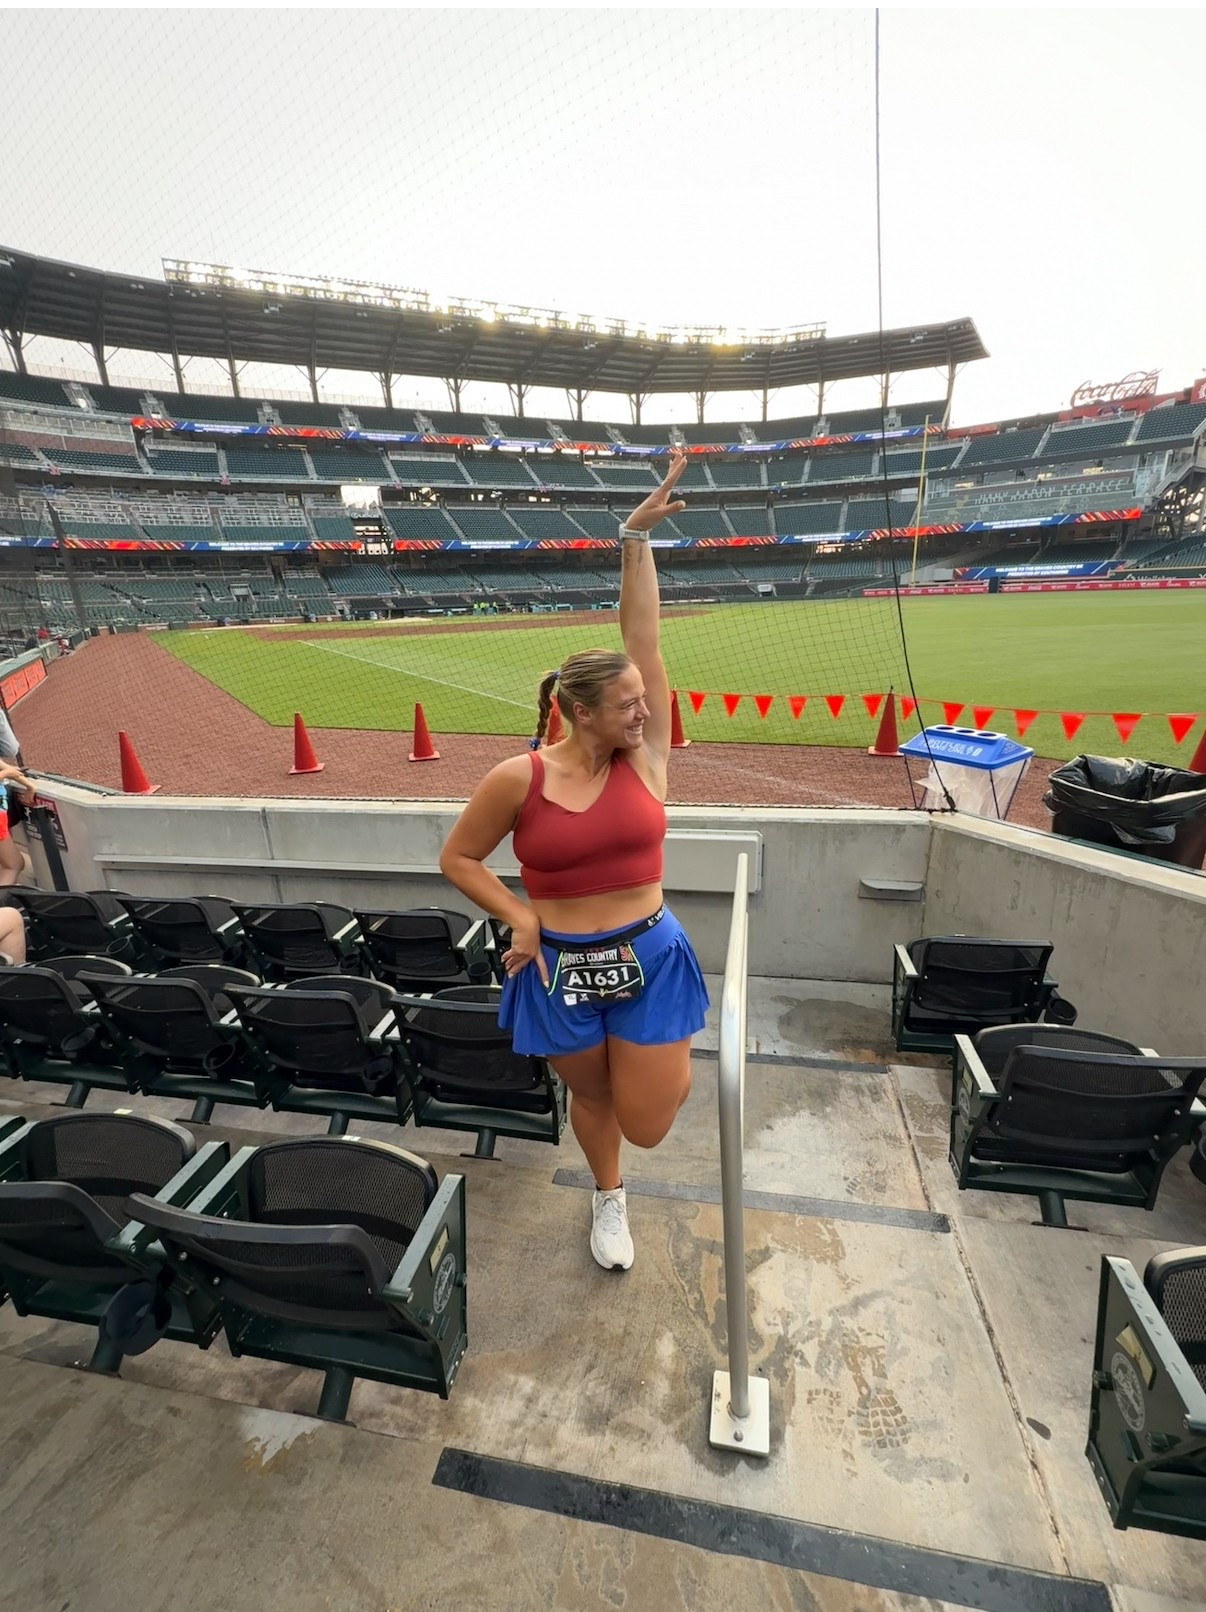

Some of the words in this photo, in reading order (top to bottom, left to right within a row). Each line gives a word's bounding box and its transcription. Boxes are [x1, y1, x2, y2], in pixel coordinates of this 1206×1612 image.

[975, 491, 1009, 505] HANK
[1010, 486, 1056, 501] AARON
[1060, 480, 1126, 496] TERRACE
[586, 948, 618, 963] COUNTRY
[567, 966, 630, 987] A1631
